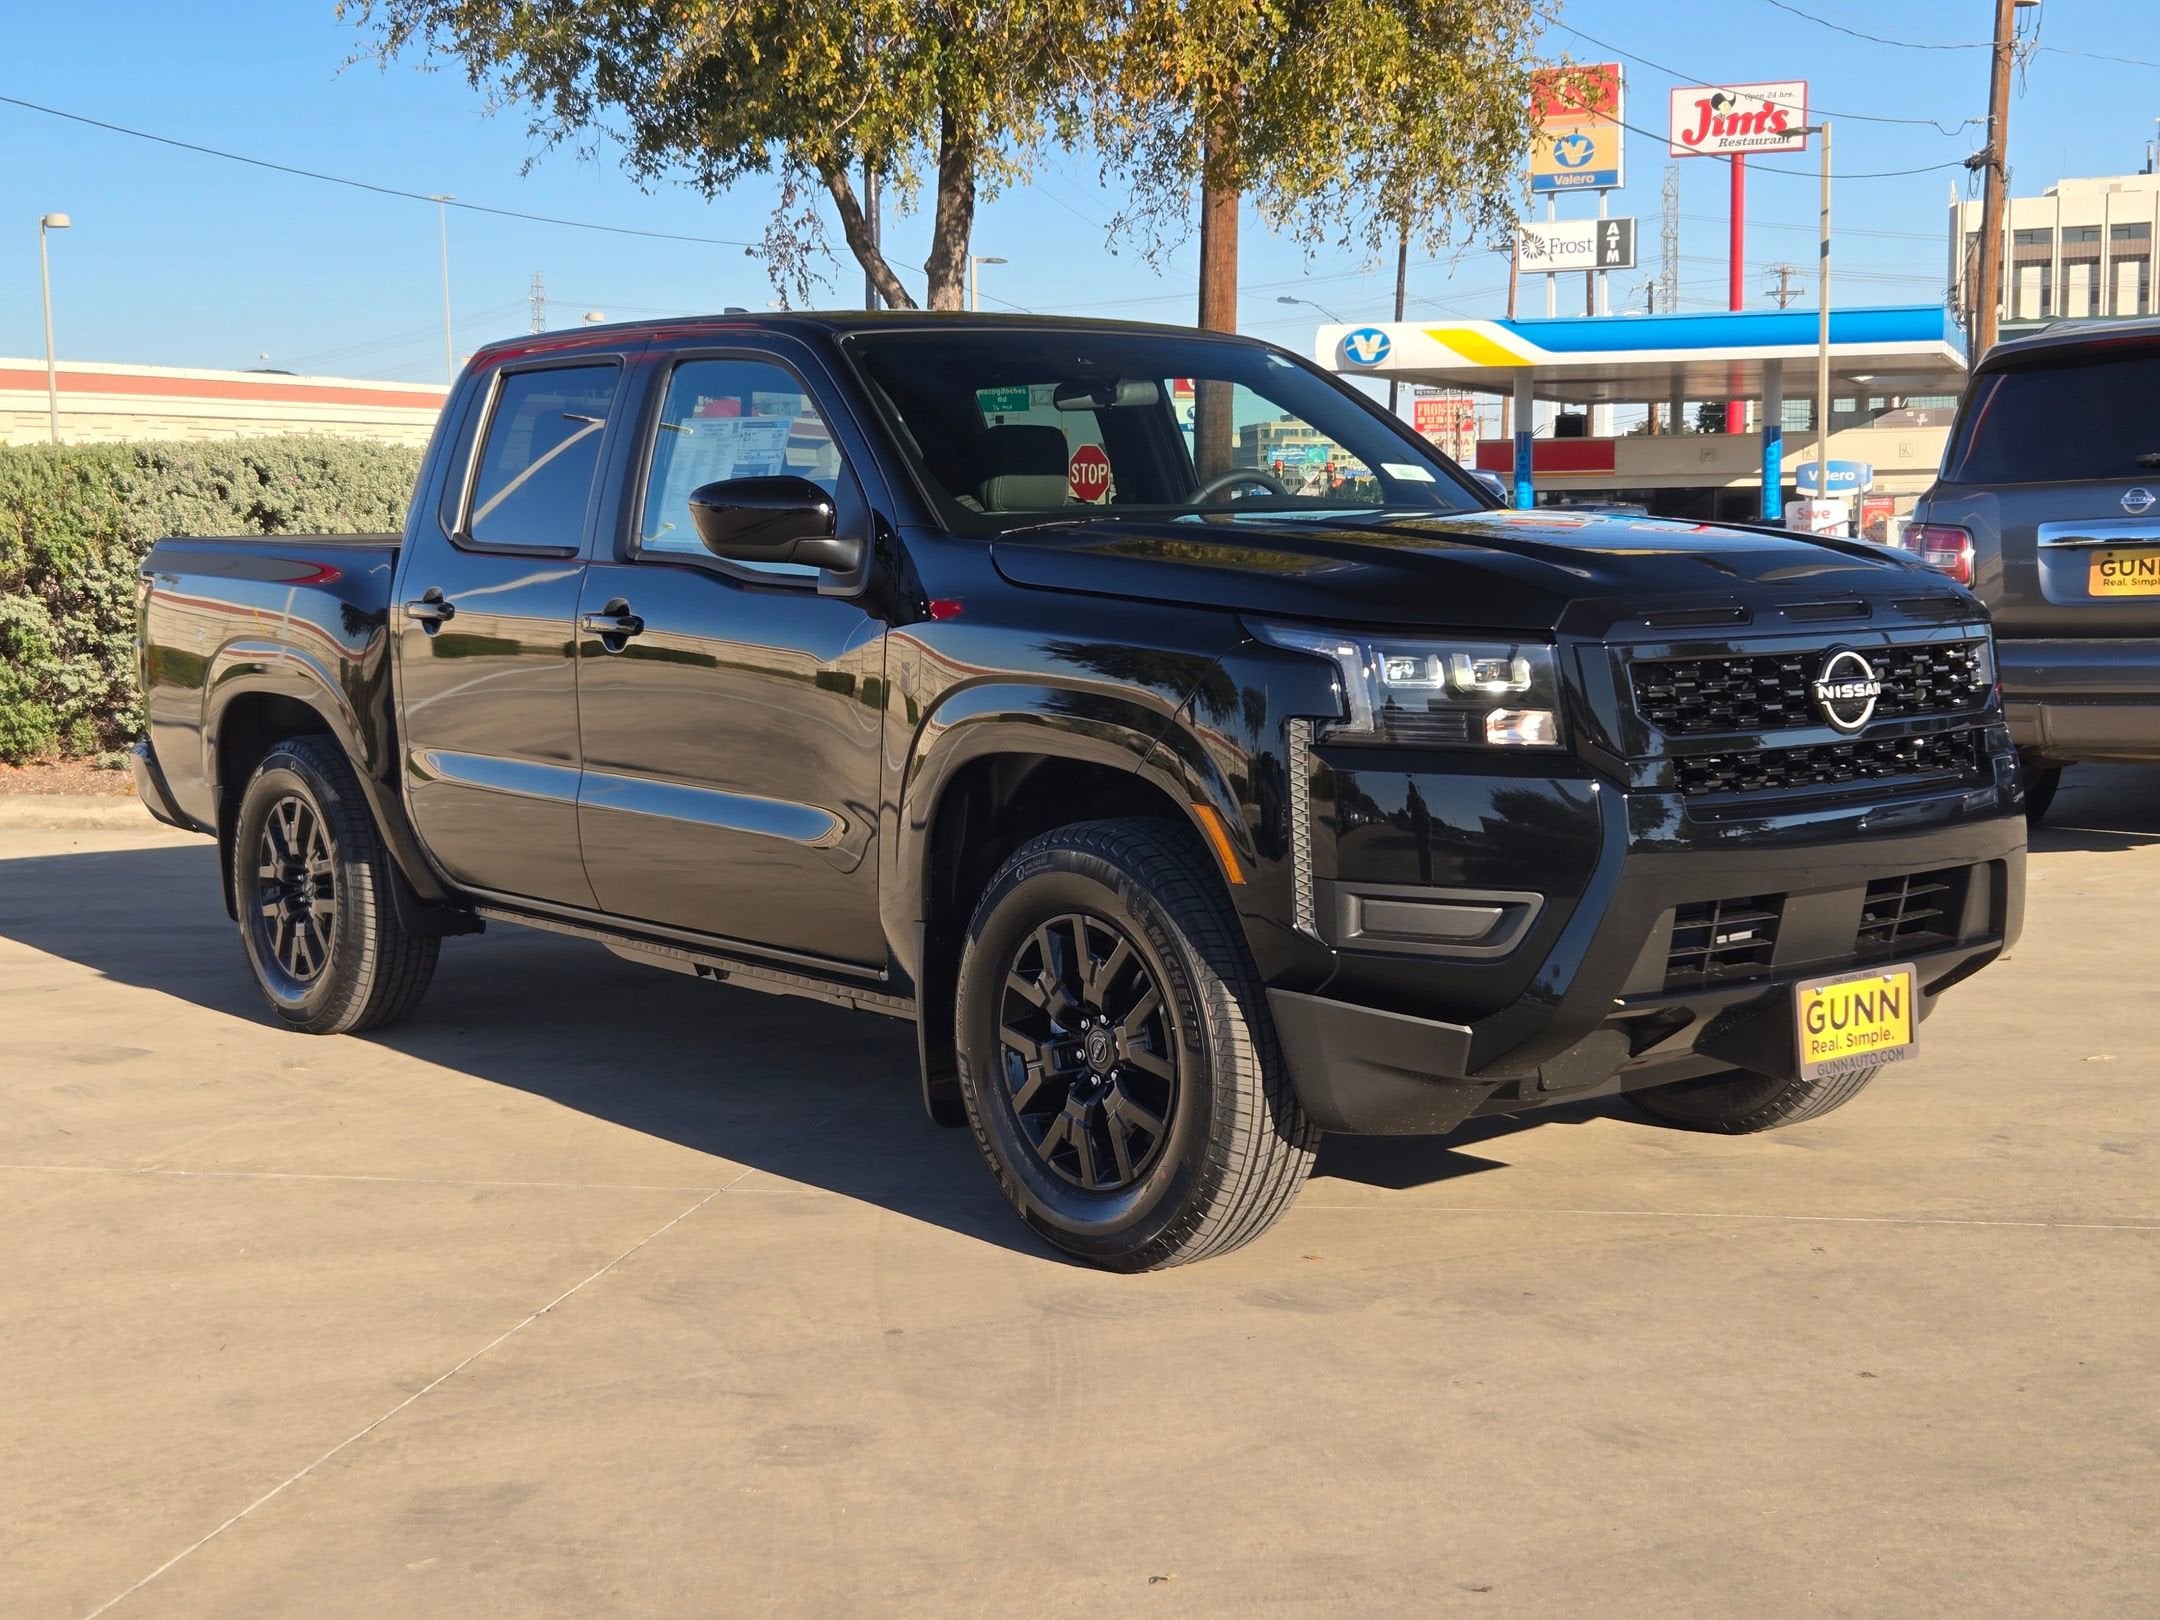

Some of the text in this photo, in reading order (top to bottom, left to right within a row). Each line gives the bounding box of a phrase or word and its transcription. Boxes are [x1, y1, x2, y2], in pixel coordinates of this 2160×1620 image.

[1744, 93, 1765, 102] Open
[1766, 91, 1777, 99] 24
[1682, 99, 1789, 146] Jim's
[1718, 136, 1791, 148] Restaurant
[1553, 174, 1596, 186] Valero
[1549, 237, 1594, 255] Frost
[1606, 222, 1620, 263] ATM
[1071, 463, 1108, 485] STOP
[1808, 469, 1855, 481] Vlero
[1797, 507, 1831, 520] Save
[2100, 559, 2160, 577] GUN
[2103, 578, 2128, 587] Real.
[1817, 681, 1881, 699] NISSAN
[1149, 925, 1200, 1048] MICHELIN
[1806, 987, 1900, 1034] GUNN
[1812, 1027, 1895, 1055] Real. Simple.
[1817, 1048, 1904, 1076] GUNNAUTO.COM
[956, 1056, 1000, 1171] MICHELIN
